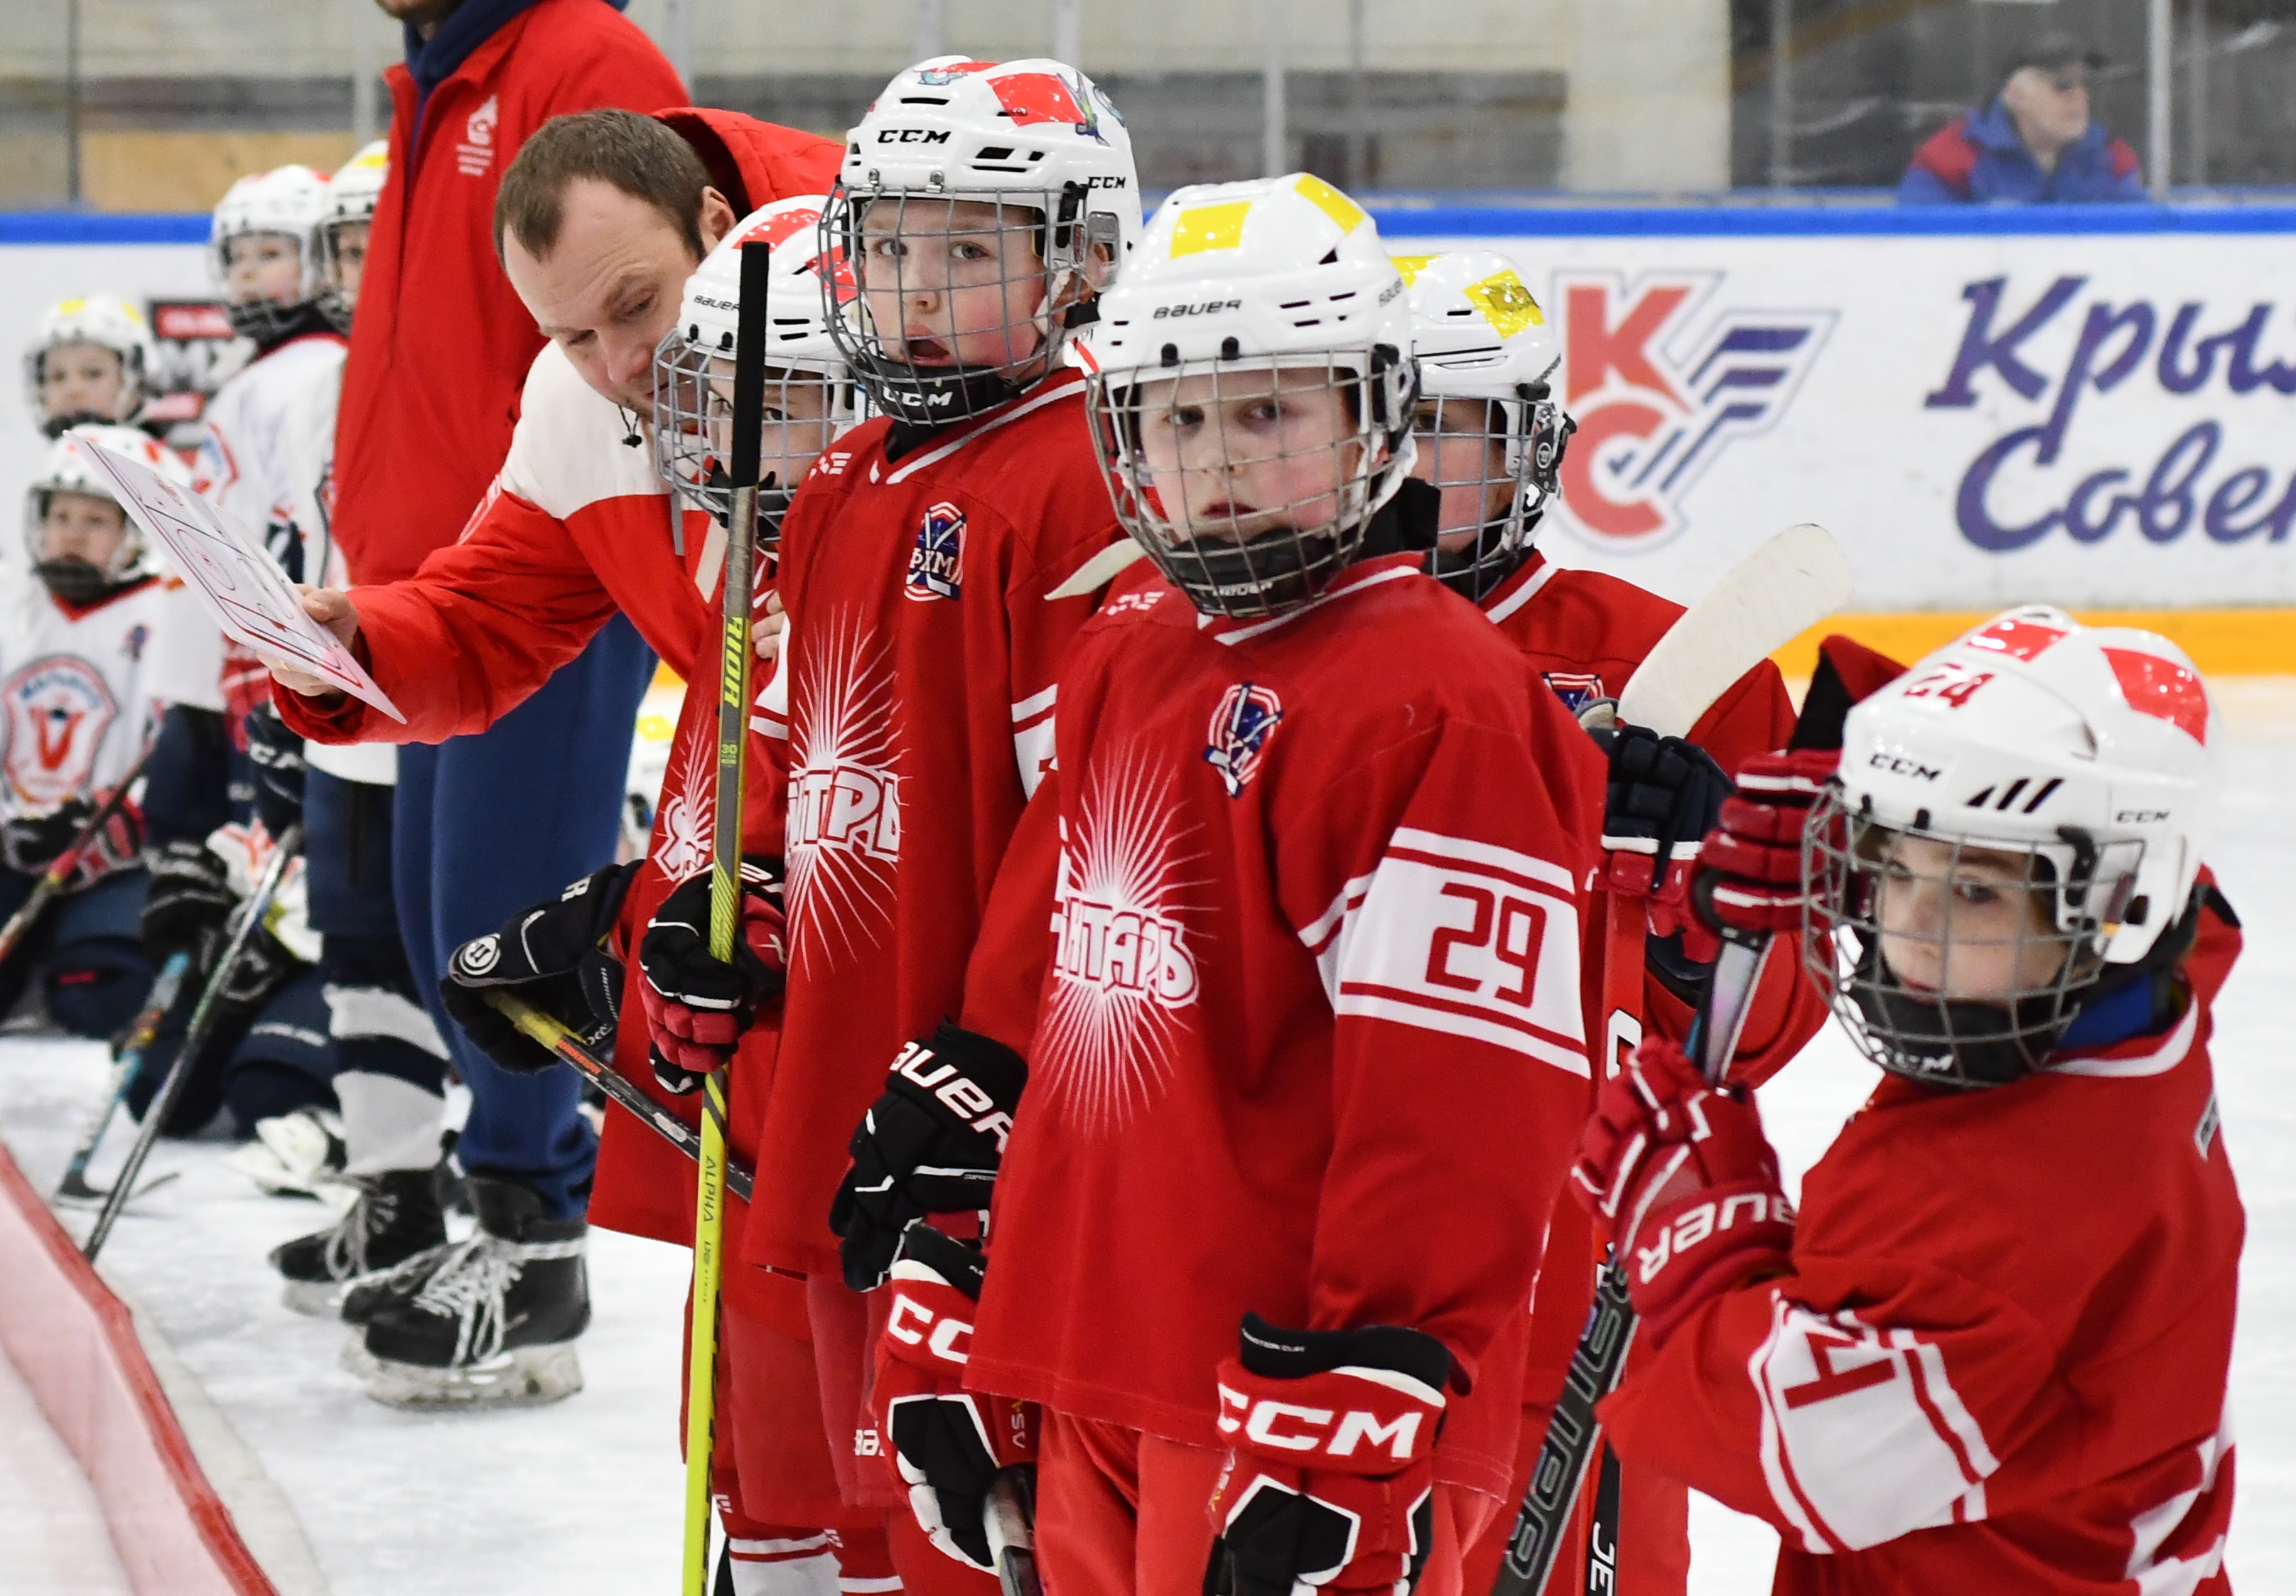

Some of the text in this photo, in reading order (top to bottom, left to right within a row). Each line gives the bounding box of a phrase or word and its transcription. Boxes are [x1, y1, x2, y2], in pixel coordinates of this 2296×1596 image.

[876, 129, 952, 144] CCM
[1087, 176, 1126, 190] CCM
[1153, 299, 1242, 319] BAUER
[883, 385, 953, 406] CCM
[1924, 274, 2296, 467] Кры
[1956, 419, 2296, 553] Сове
[1902, 662, 1995, 708] 24
[1869, 753, 1942, 782] CCM
[2116, 809, 2170, 823] CCM
[1425, 883, 1546, 1009] 29
[889, 1041, 1014, 1155] AUER
[1637, 1193, 1798, 1285] AUER
[888, 1293, 975, 1364] CC
[1217, 1383, 1423, 1459] CCM
